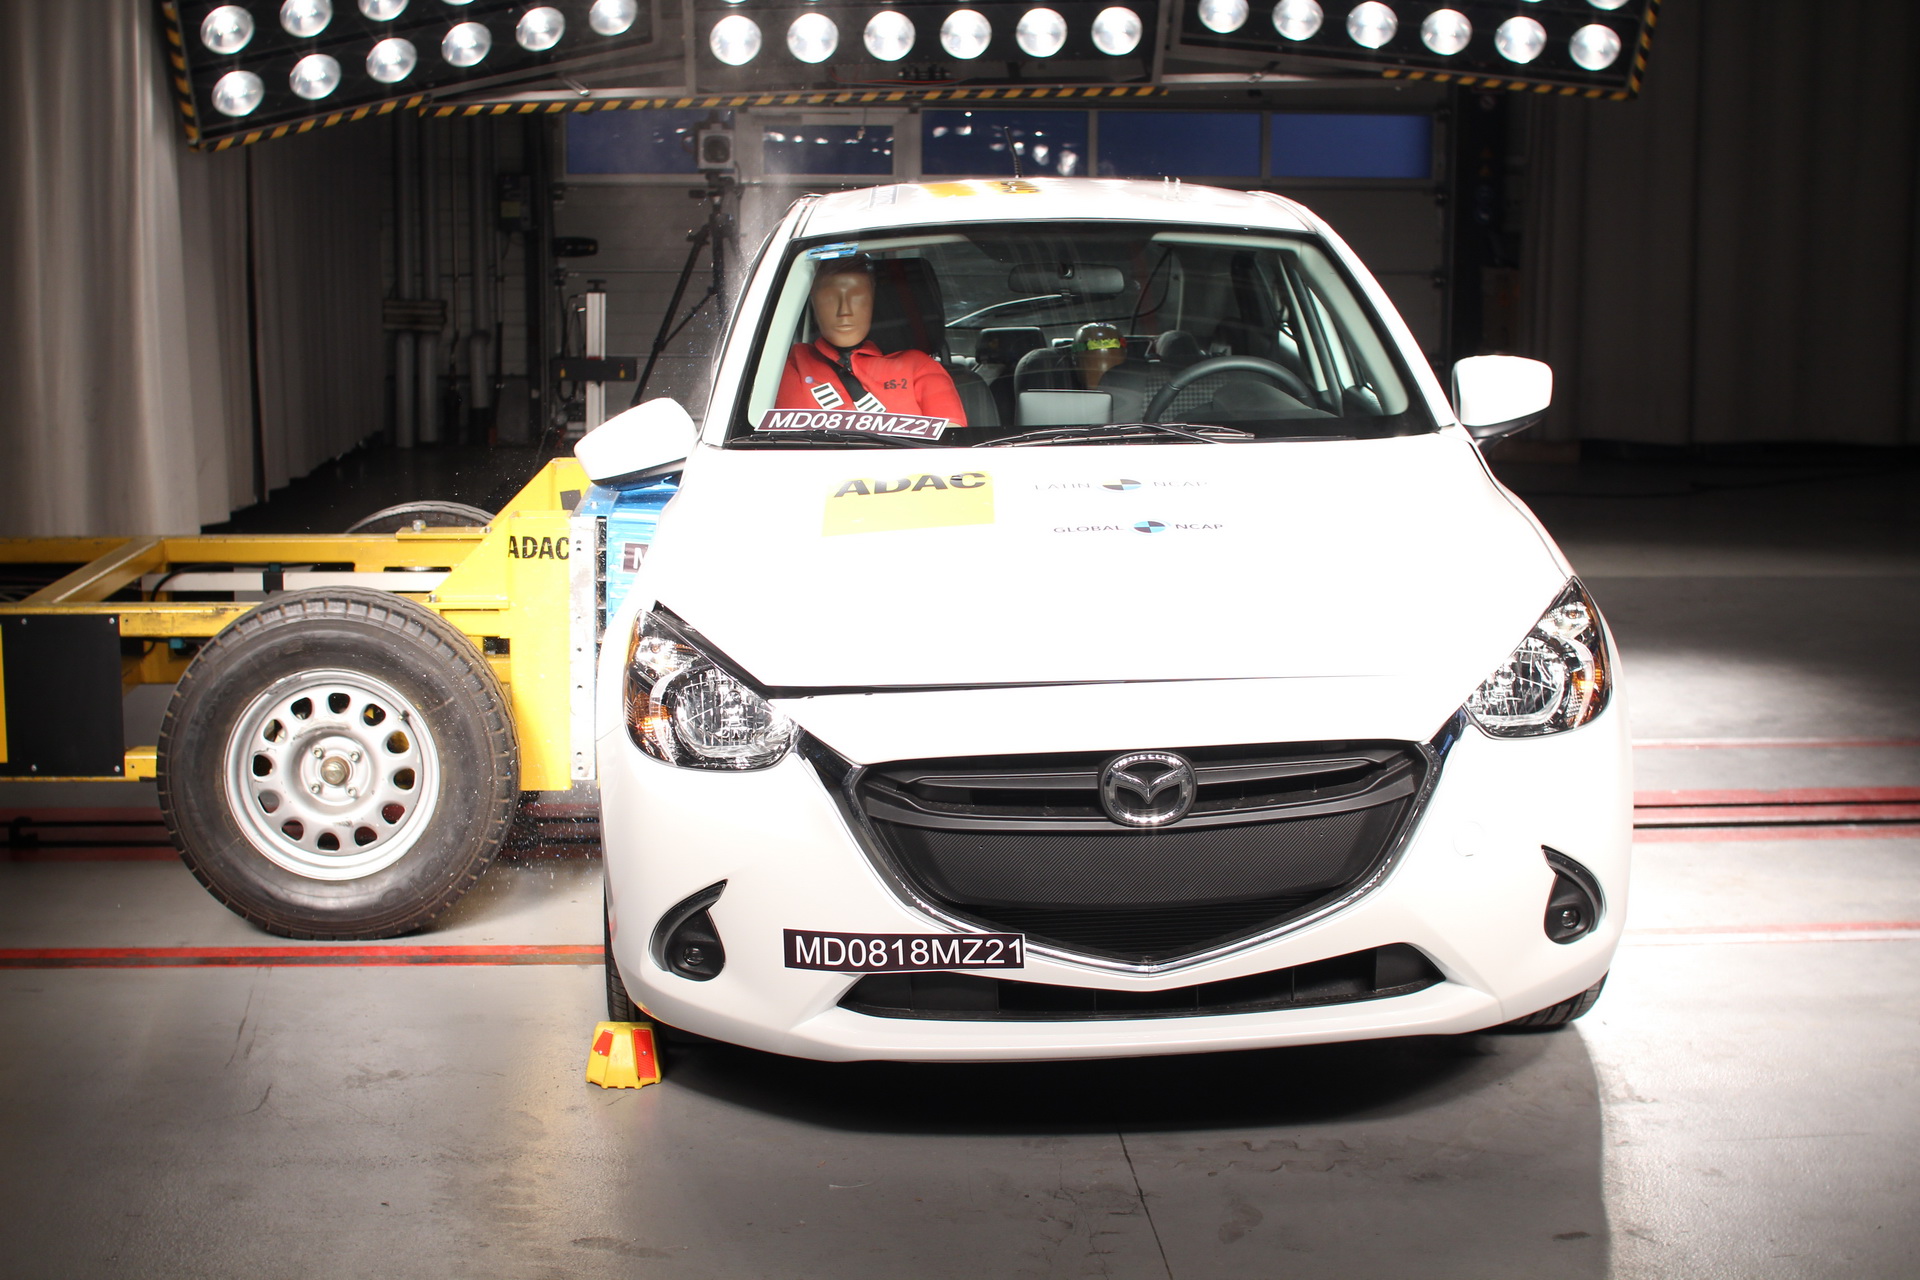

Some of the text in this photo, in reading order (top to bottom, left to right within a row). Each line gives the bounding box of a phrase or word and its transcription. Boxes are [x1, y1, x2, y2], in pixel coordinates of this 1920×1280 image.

[883, 378, 908, 390] ES-2
[768, 411, 944, 437] MD0818MZ21
[833, 472, 987, 498] ADAC
[1053, 525, 1125, 534] GLOBAL
[507, 535, 570, 560] ADAC
[794, 934, 1022, 968] MD0818MZ21
